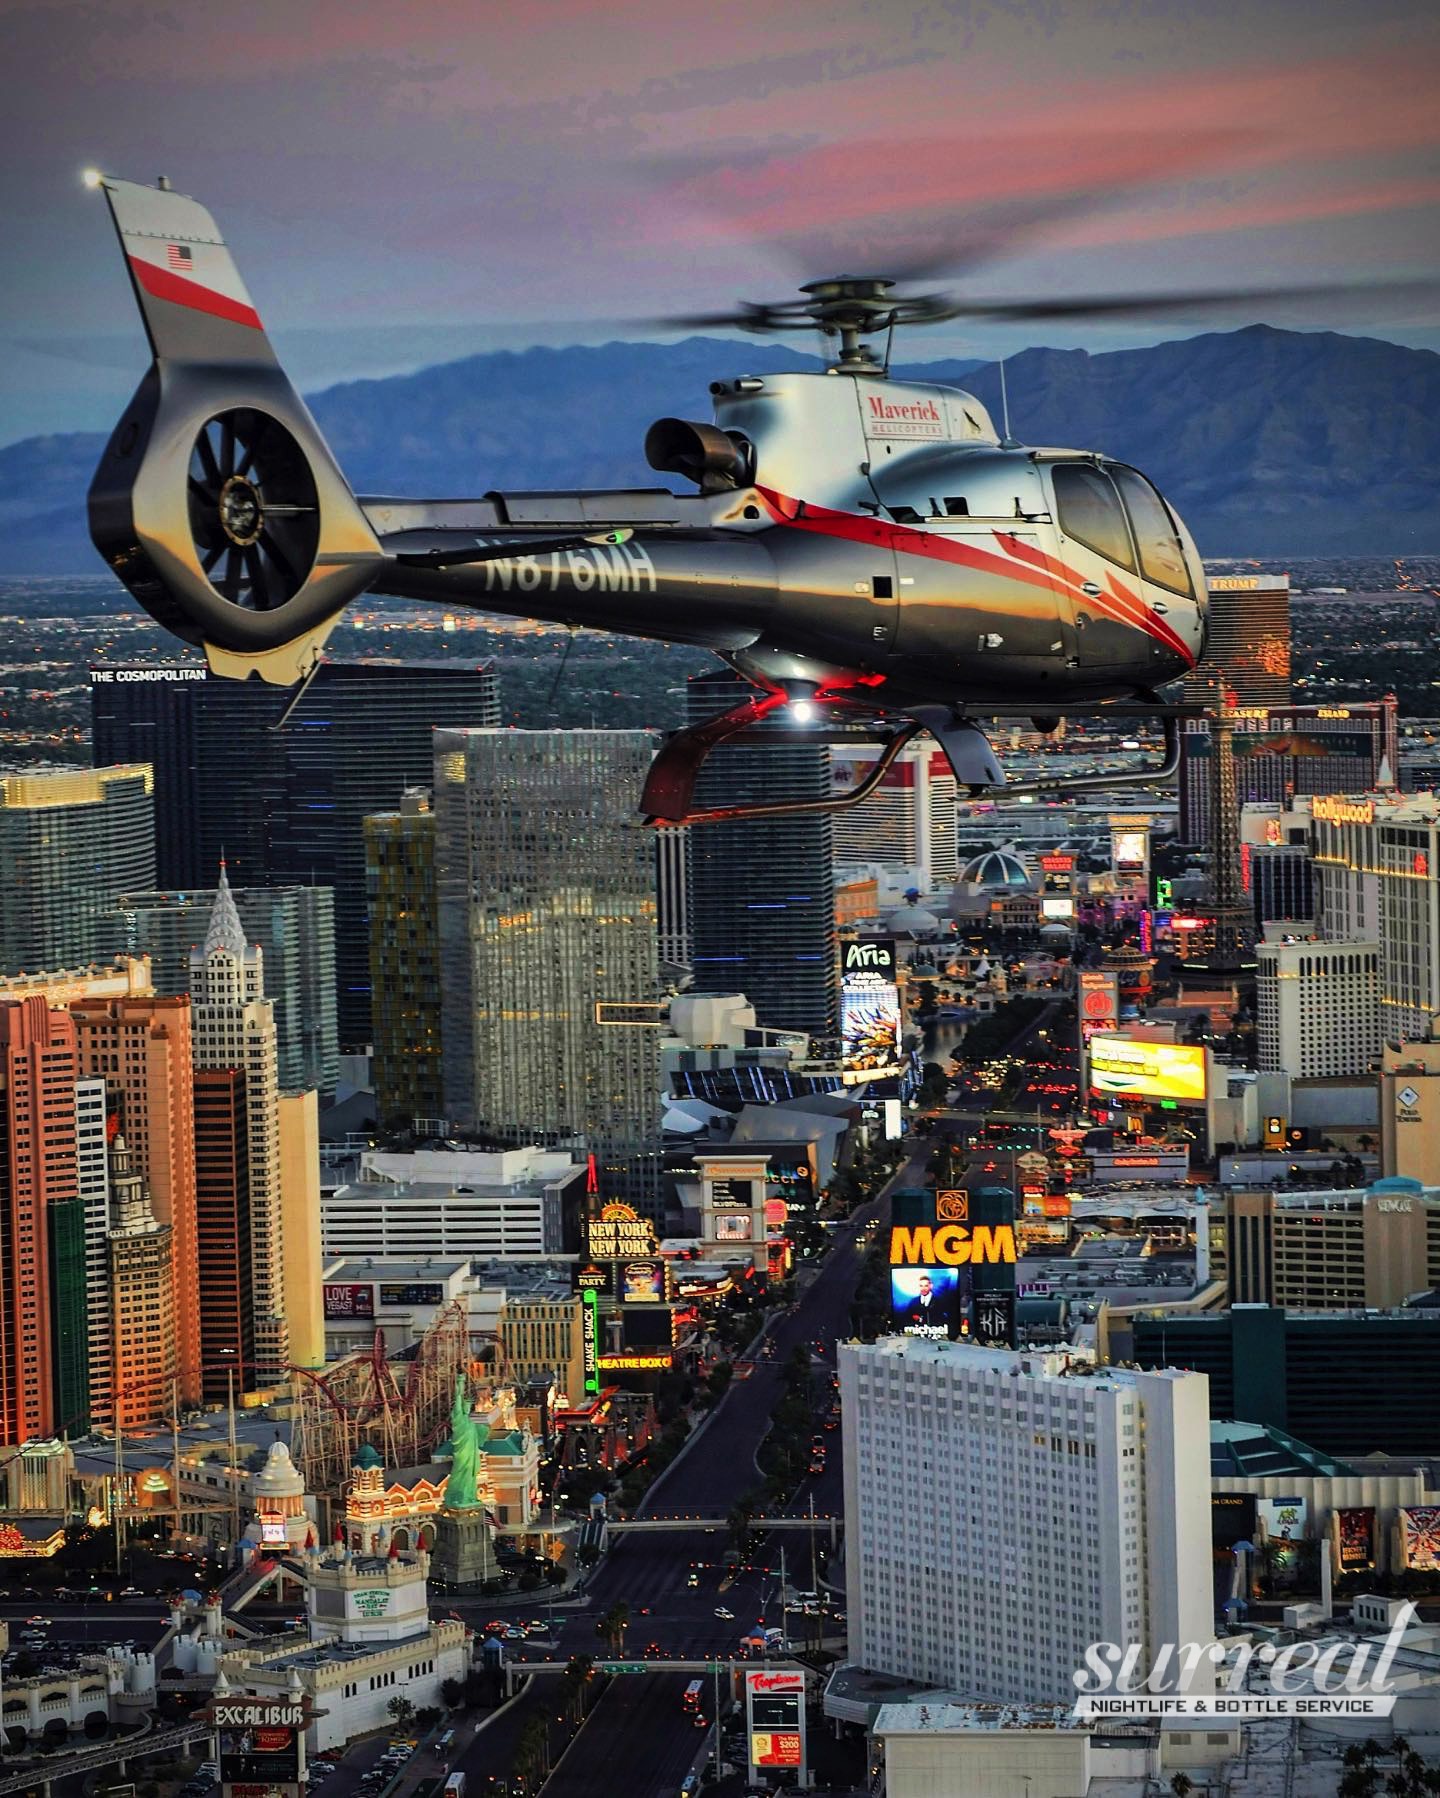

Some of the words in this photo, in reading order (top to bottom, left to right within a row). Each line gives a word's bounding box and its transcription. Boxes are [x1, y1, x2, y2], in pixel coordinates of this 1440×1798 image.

[867, 397, 940, 420] Maverick
[1211, 578, 1258, 589] TRUMP
[90, 671, 113, 682] THE
[116, 670, 206, 682] COSMOPOLITAN
[1313, 796, 1373, 827] hollywood
[846, 944, 891, 968] Aria
[589, 1222, 616, 1237] NEW
[617, 1222, 650, 1237] YORK
[589, 1240, 616, 1254] NEW
[618, 1239, 649, 1254] YORK
[889, 1224, 1018, 1266] MGM
[326, 1287, 352, 1301] LOVE
[327, 1301, 353, 1310] VEGAS?
[584, 1308, 594, 1339] SHACK
[904, 1324, 948, 1337] michael
[585, 1342, 595, 1372] SHAKE
[640, 1357, 662, 1368] BOX
[215, 1705, 304, 1725] EXCALIBUR
